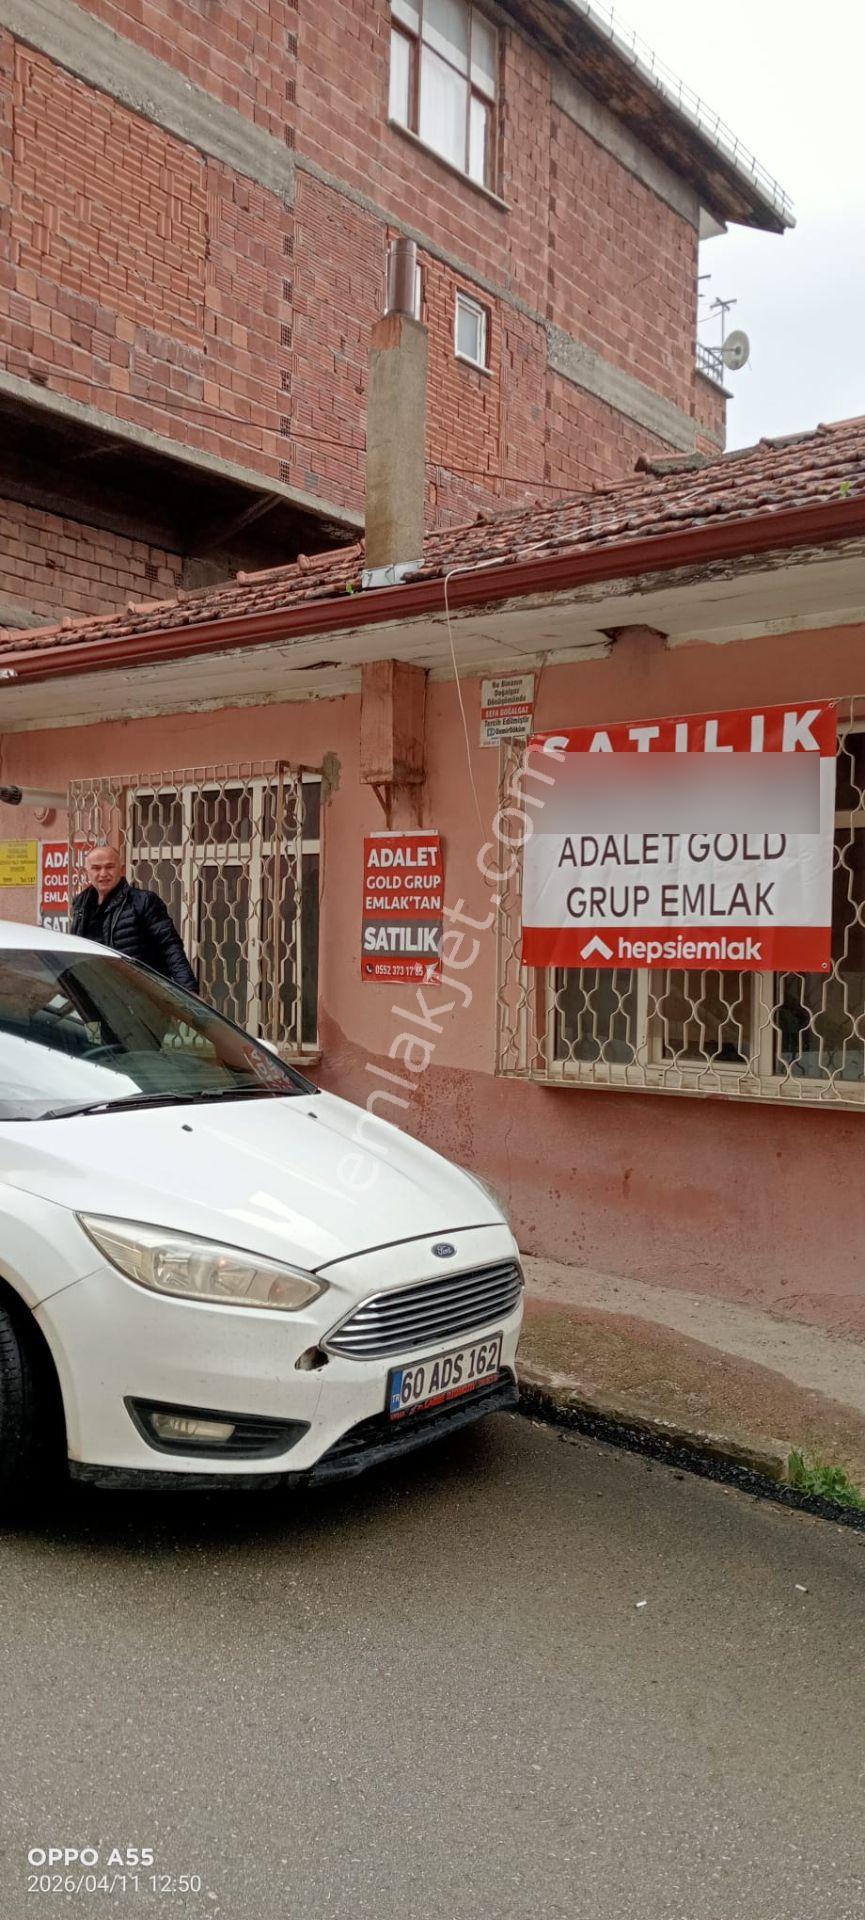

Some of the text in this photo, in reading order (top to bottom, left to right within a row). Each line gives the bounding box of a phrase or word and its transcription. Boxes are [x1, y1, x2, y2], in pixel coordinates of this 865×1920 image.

[367, 847, 438, 868] ADALET
[558, 834, 787, 868] ADALET GOLD
[366, 875, 441, 890] GOLD GRUP
[566, 882, 775, 918] GRUP EMLAK
[363, 926, 440, 952] SATILIK
[618, 935, 762, 963] hepsiemlak
[375, 964, 391, 976] 0552
[392, 965, 405, 976] 373
[406, 966, 414, 976] 17
[401, 1367, 425, 1403] 60
[428, 1353, 464, 1394] ADS
[467, 1342, 498, 1379] 162
